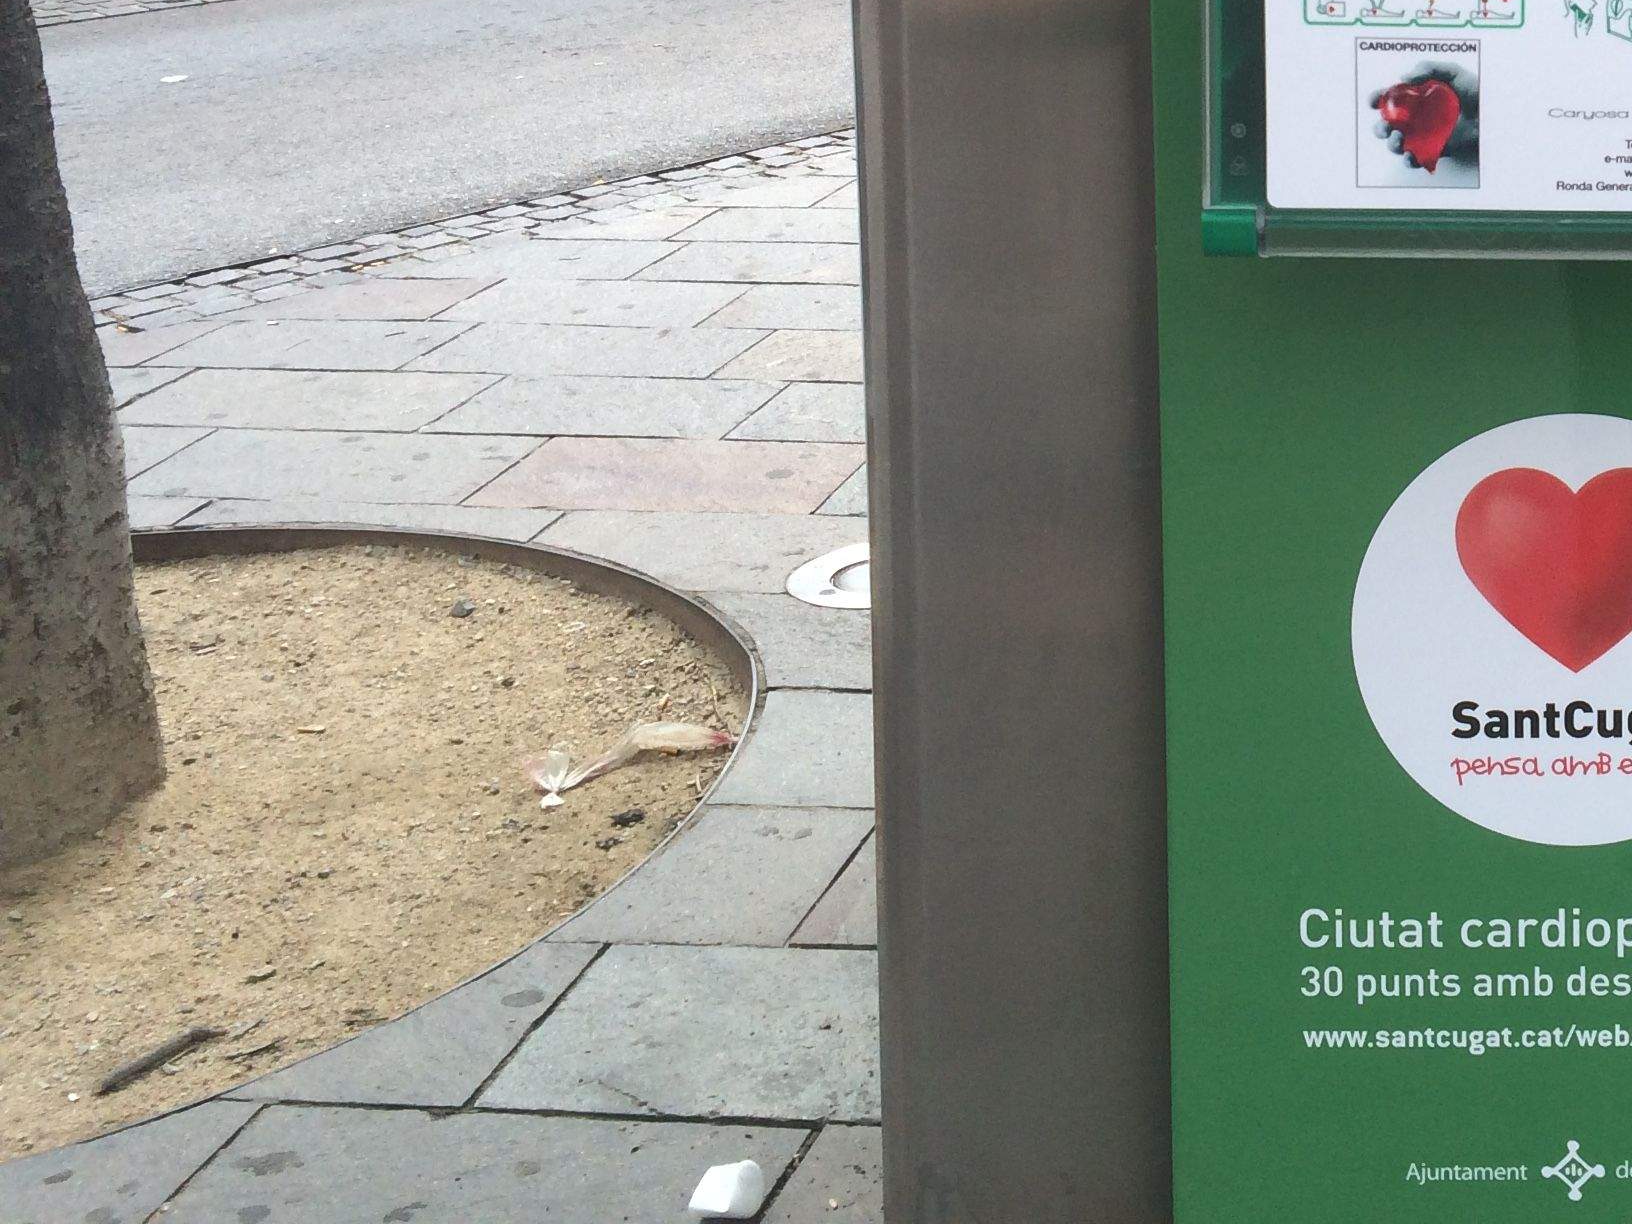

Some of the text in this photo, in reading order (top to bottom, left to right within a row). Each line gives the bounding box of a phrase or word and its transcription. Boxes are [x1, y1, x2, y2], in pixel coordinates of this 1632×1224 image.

[1359, 41, 1477, 53] CARDIOPROTECCIÓN
[1548, 108, 1629, 120] Caryosa
[1556, 180, 1593, 192] Ronda
[1450, 754, 1545, 785] pensa
[1299, 908, 1444, 949] Ciutat
[1300, 966, 1344, 998] 30
[1357, 967, 1461, 1005] punts
[1473, 966, 1554, 998] amb
[1406, 1162, 1528, 1183] Ajuntament
